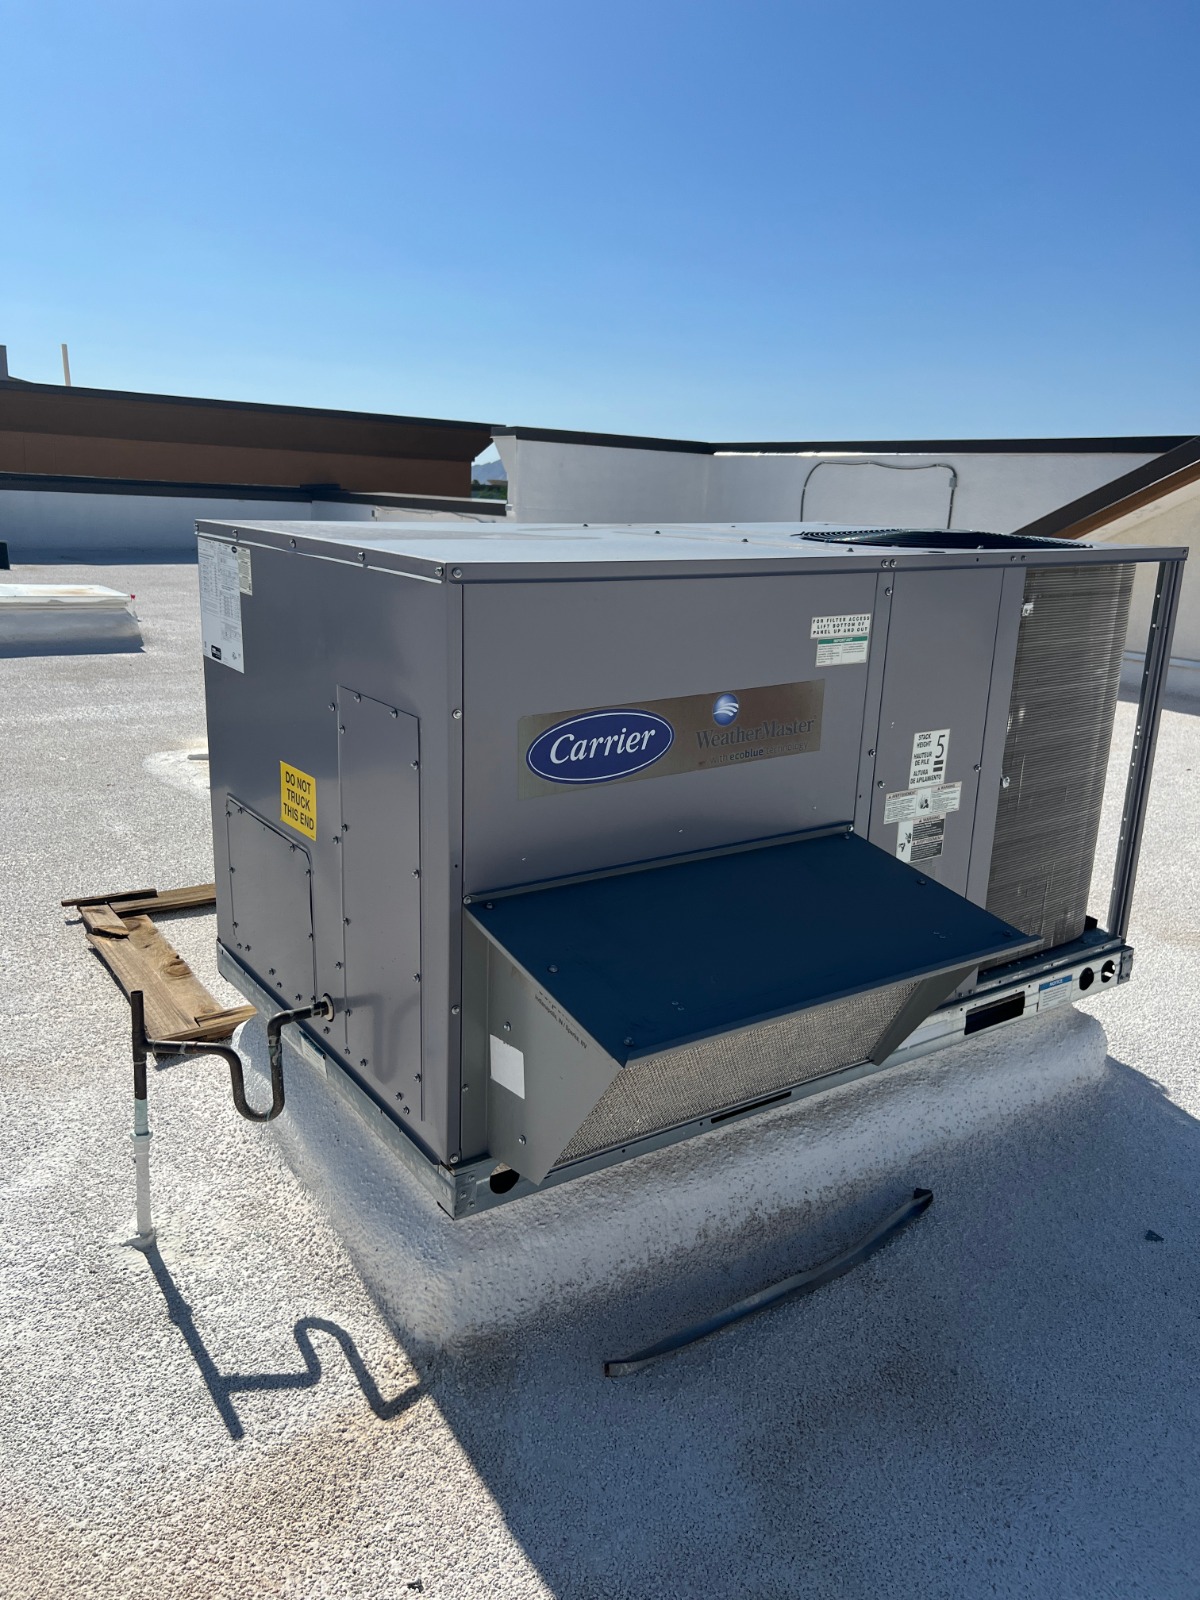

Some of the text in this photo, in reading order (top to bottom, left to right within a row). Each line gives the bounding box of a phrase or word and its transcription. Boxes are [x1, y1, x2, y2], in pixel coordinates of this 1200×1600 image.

[695, 719, 815, 750] WeatherMaster
[916, 740, 932, 748] HEIGHT
[918, 733, 931, 741] STACK
[549, 727, 656, 765] Carrier
[729, 748, 764, 761] ecoblue
[913, 751, 933, 760] HAUTEUR
[935, 734, 946, 759] 5
[285, 770, 312, 795] DO NOT
[910, 777, 916, 785] DE
[913, 769, 929, 777] ALTURA
[286, 787, 311, 812] TRUCK
[283, 802, 314, 831] THIS END
